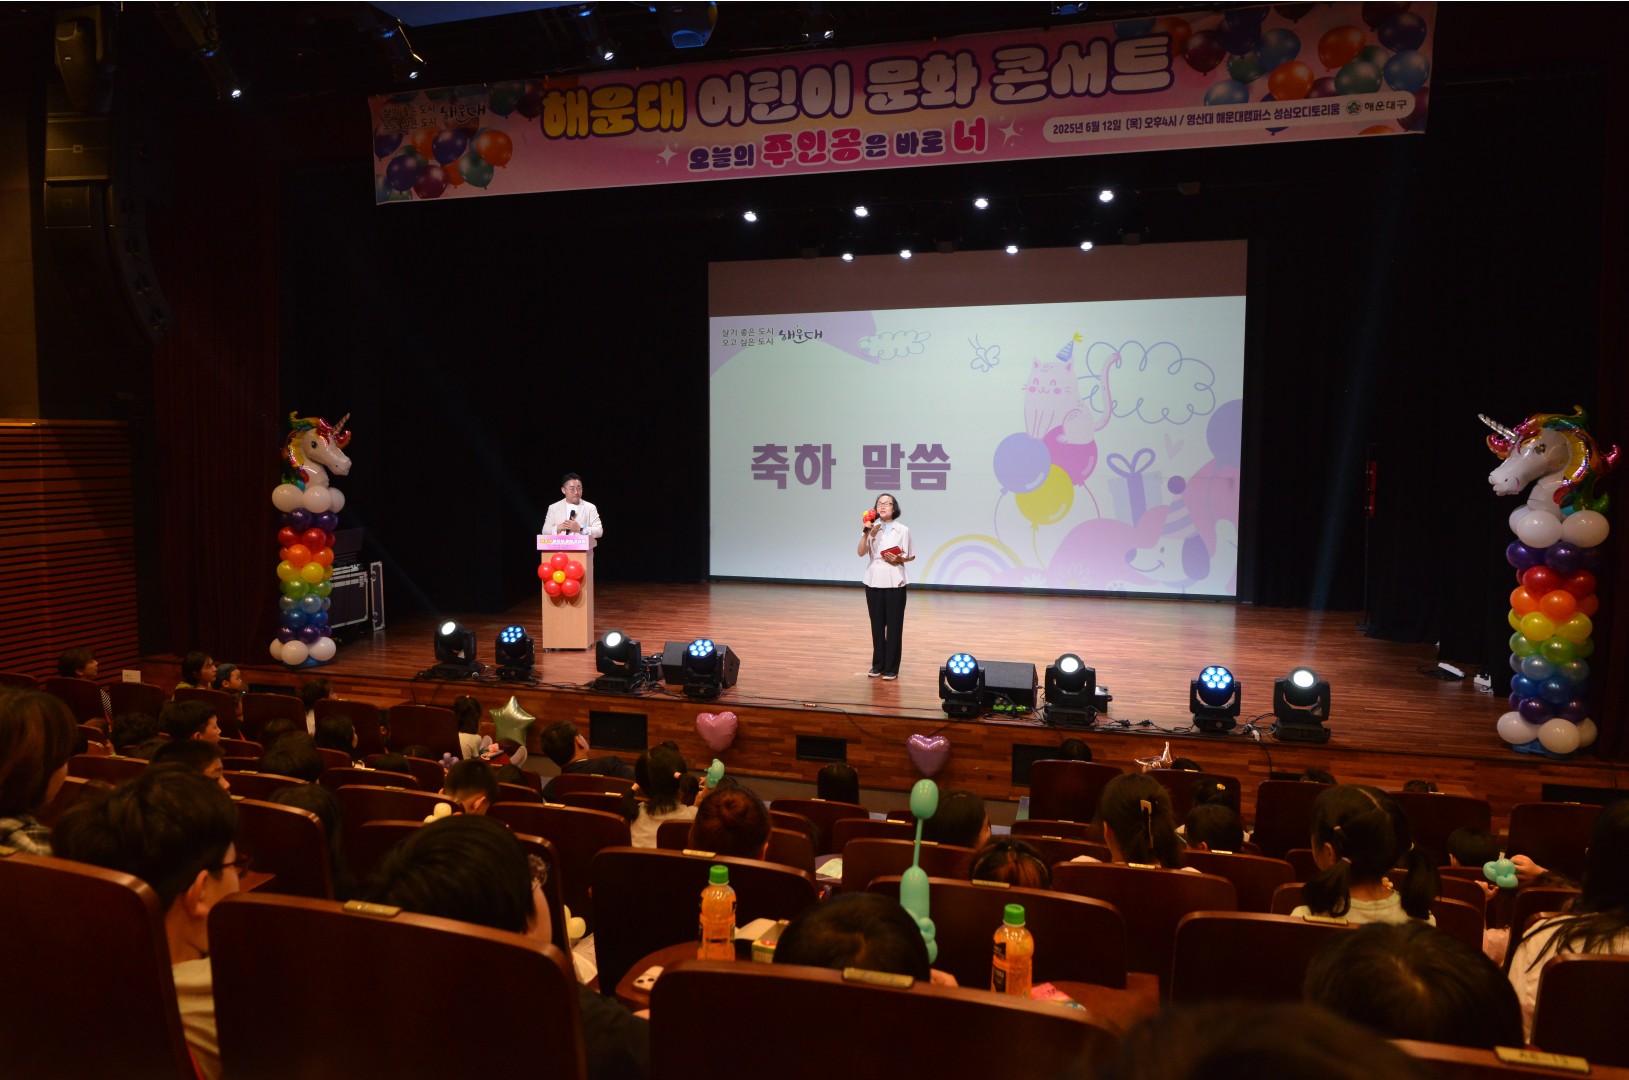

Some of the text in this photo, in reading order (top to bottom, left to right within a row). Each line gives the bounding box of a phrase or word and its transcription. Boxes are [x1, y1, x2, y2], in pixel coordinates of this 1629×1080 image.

[541, 33, 1174, 140] 해운대 어린이 문화 콘서트
[420, 104, 435, 114] 도시
[440, 104, 486, 123] 해운대
[1364, 100, 1407, 111] 해운대구
[421, 117, 437, 127] 도시
[1053, 121, 1083, 134] 2025년
[1085, 121, 1100, 133] 6월
[1102, 120, 1121, 131] 12일
[1144, 115, 1177, 129] 오후4시
[1187, 113, 1214, 126] 영산대
[1216, 108, 1271, 124] 해운대캠퍼스
[1273, 103, 1340, 120] 성심오디토리움
[689, 117, 985, 170] 오늘의 주인공은 바로 너
[722, 339, 737, 347] 오고
[758, 338, 774, 346] 도시
[778, 325, 823, 344] 해운대
[751, 443, 951, 491] 축하 말씀
